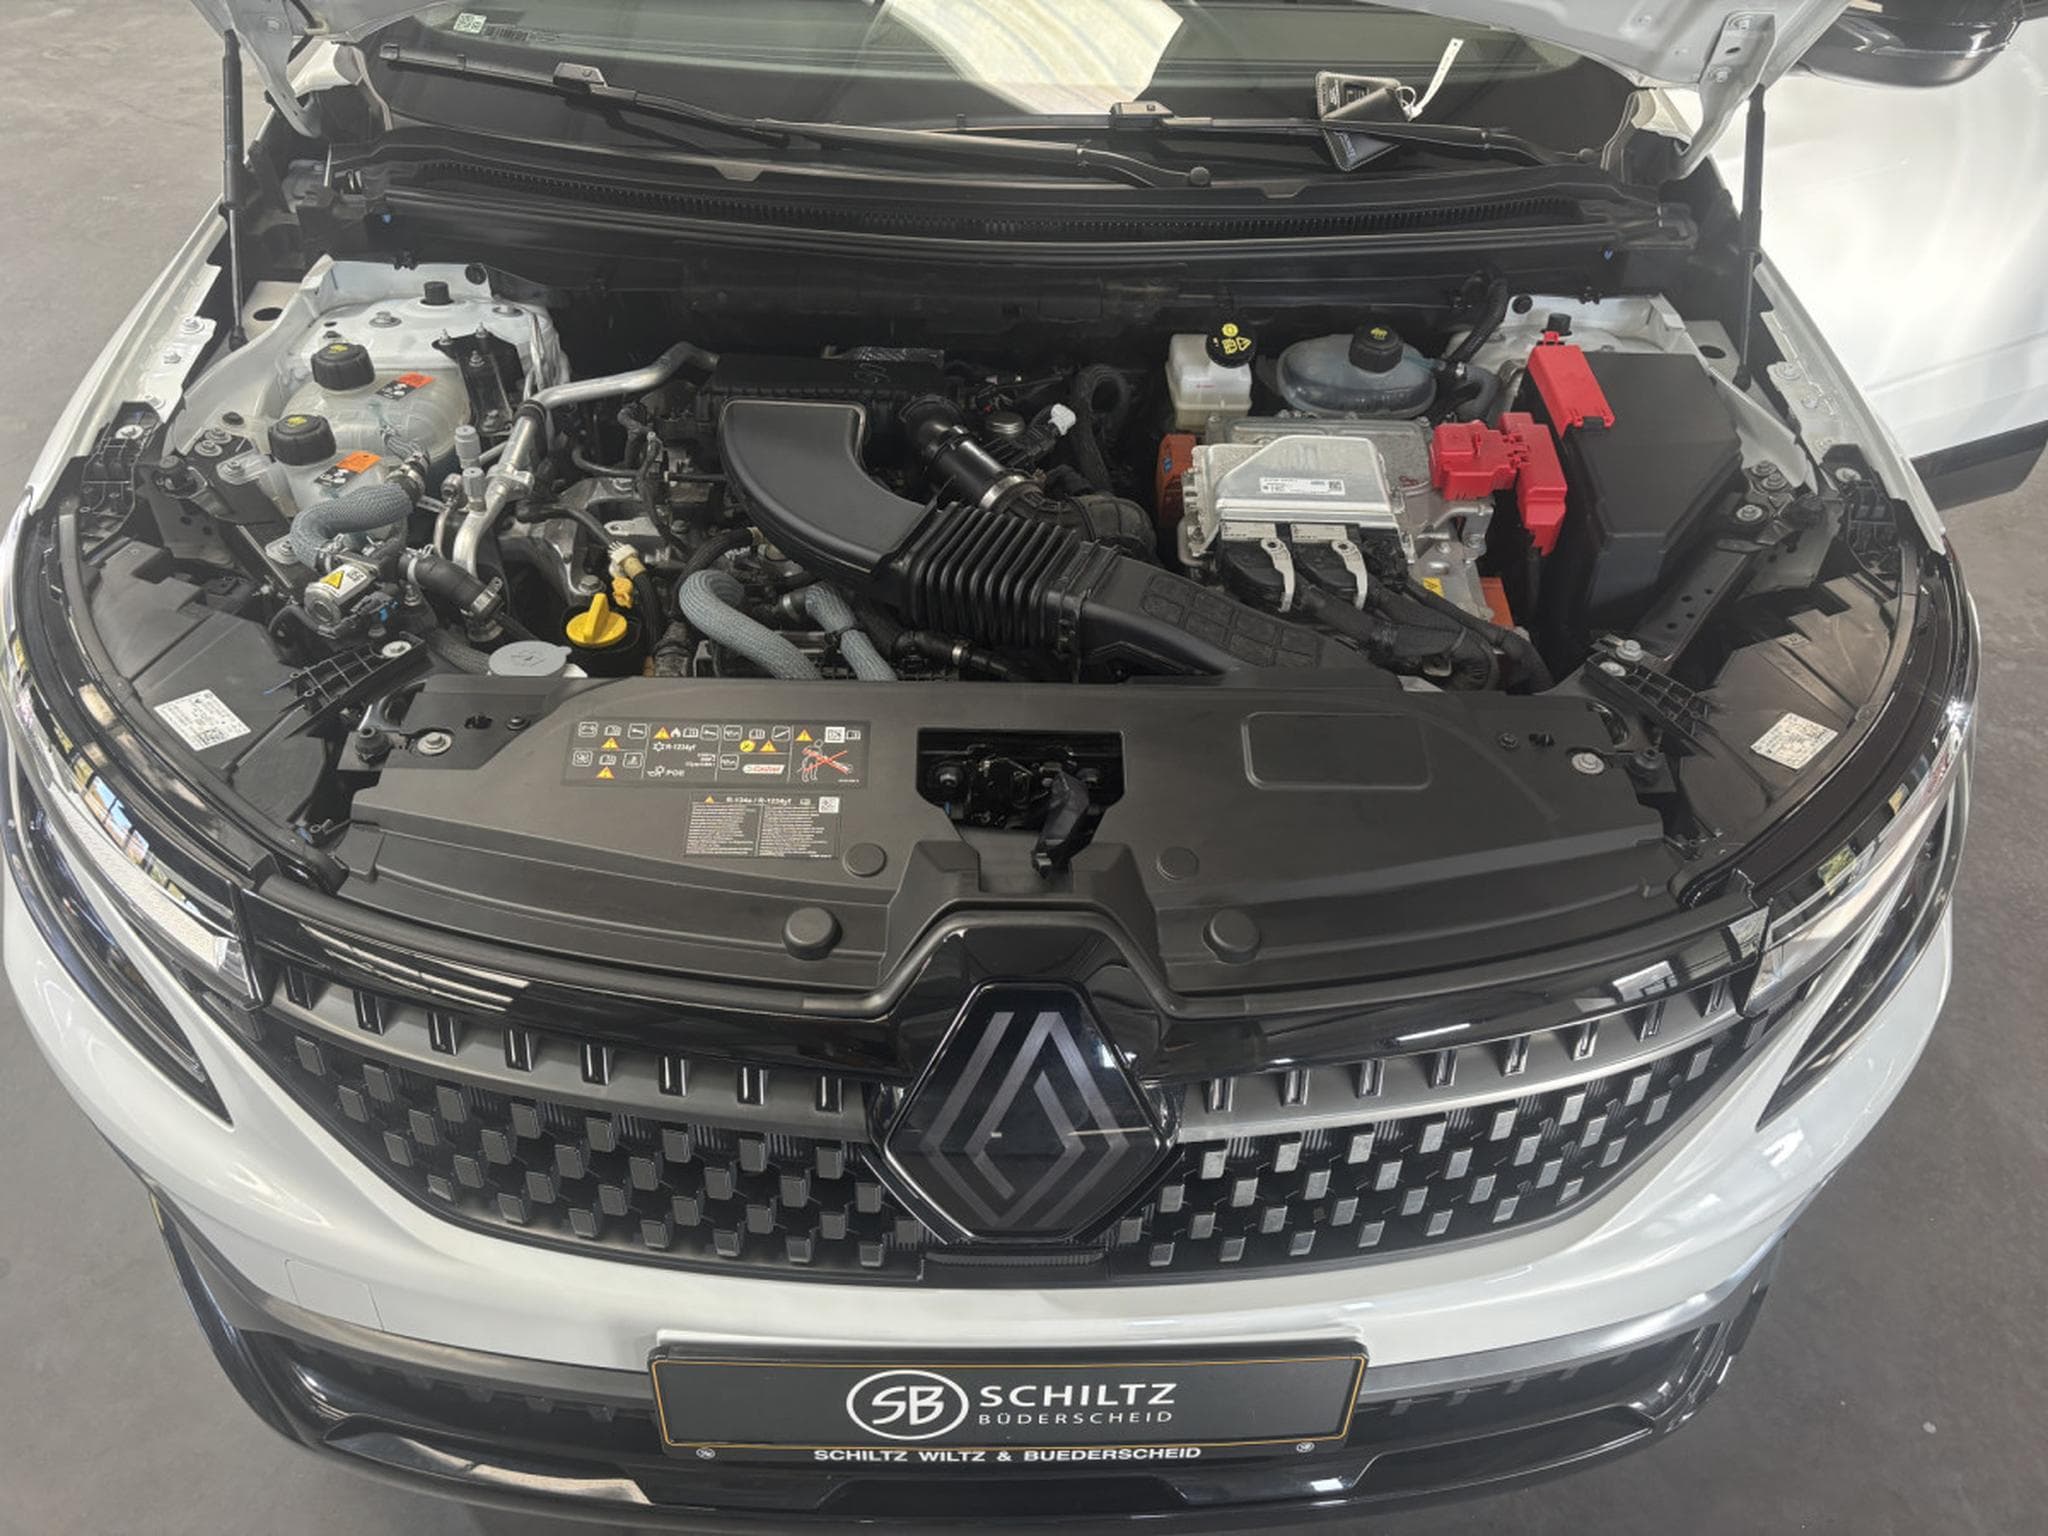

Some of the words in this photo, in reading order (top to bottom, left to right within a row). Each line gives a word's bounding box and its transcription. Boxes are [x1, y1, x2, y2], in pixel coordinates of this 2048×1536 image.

[871, 1385, 945, 1426] SB
[979, 1383, 1178, 1408] SCHILTZ
[979, 1411, 1173, 1426] BÜDERSCHEID
[813, 1449, 908, 1461] SCHILTZ
[918, 1451, 986, 1462] WILTZ
[996, 1450, 1012, 1462] &
[1023, 1447, 1202, 1462] BUEDERSCHEID
